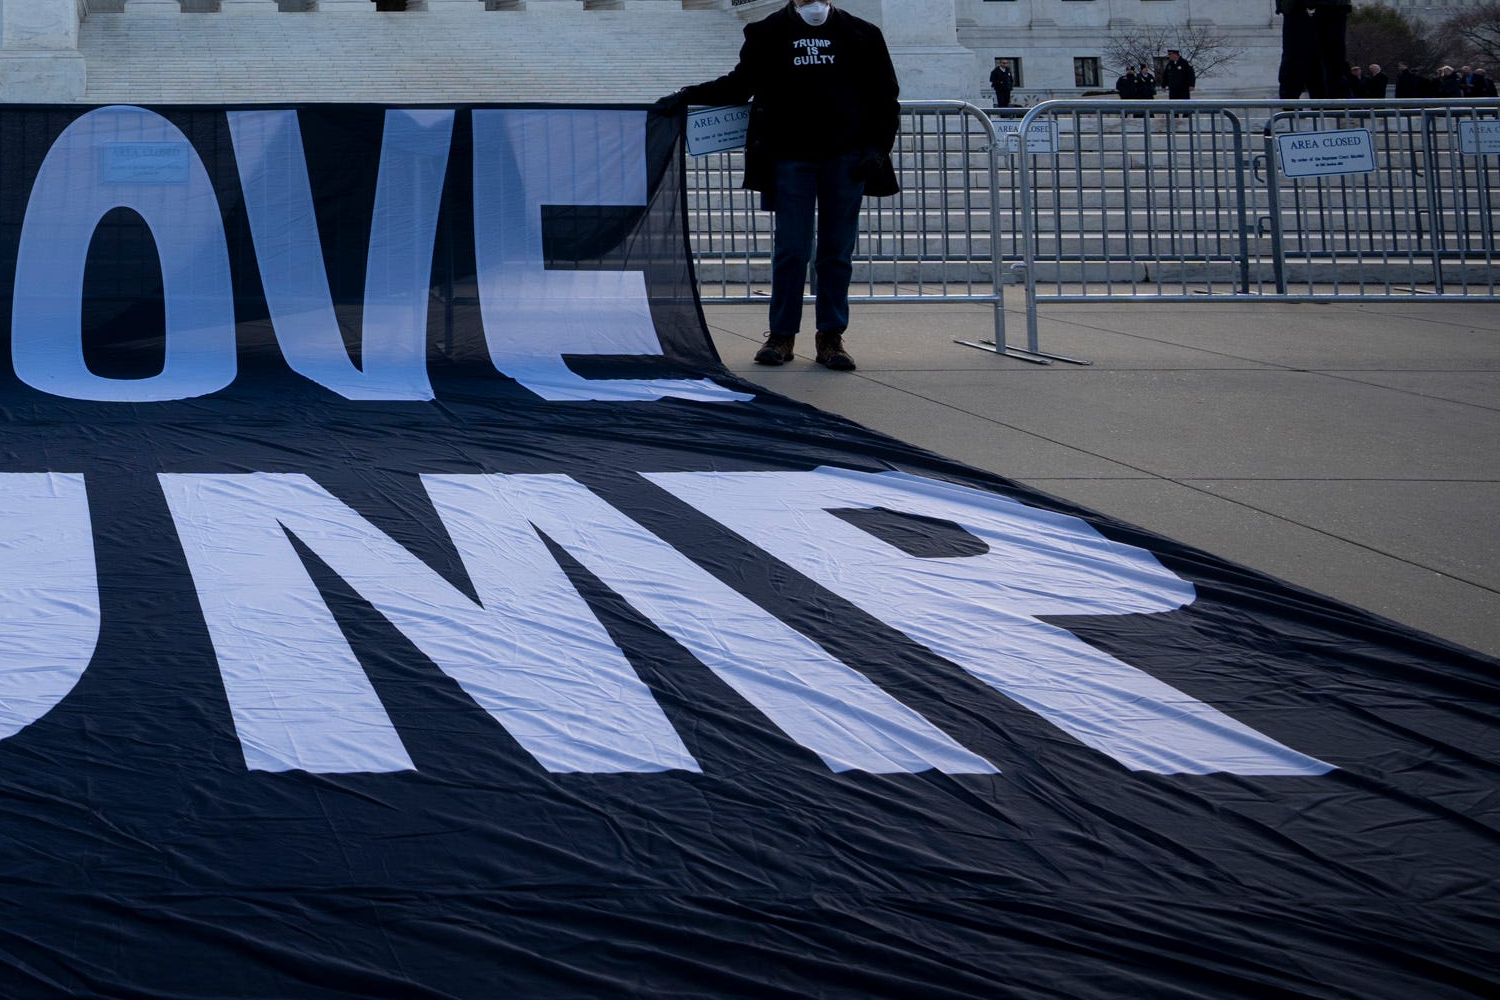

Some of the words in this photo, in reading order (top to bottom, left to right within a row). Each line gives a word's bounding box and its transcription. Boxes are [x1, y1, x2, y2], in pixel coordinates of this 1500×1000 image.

[793, 38, 831, 48] TRUMP
[807, 46, 818, 55] IS
[793, 55, 835, 65] GUILTY
[694, 116, 720, 128] AREA
[1291, 140, 1319, 150] AREA
[1323, 137, 1361, 147] CLOSED
